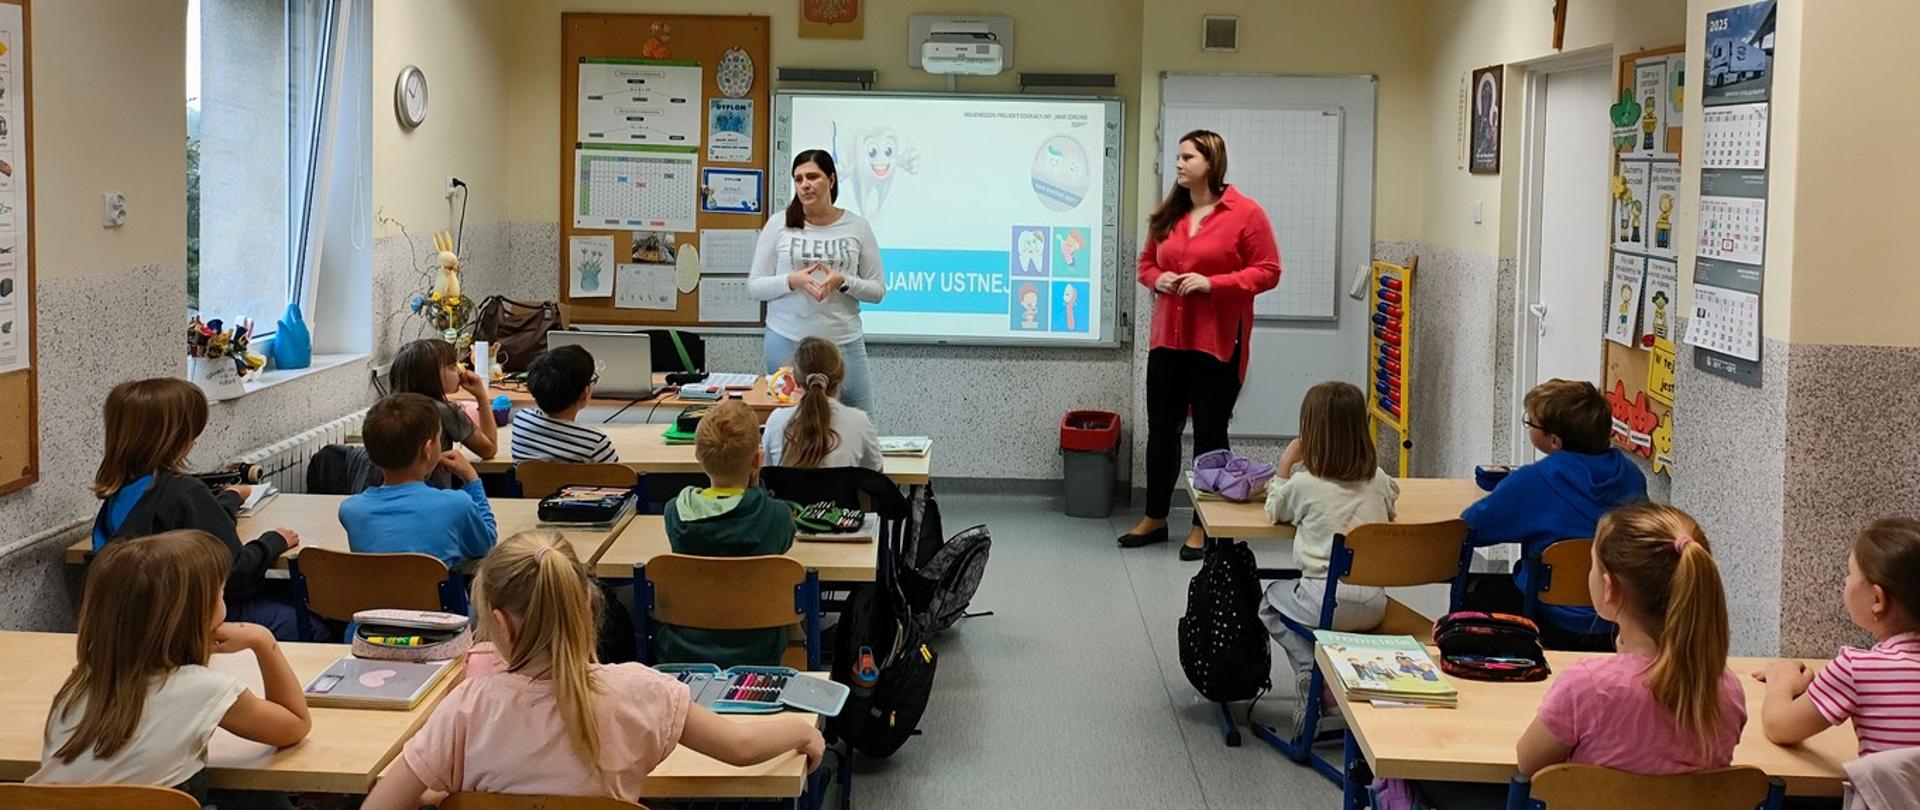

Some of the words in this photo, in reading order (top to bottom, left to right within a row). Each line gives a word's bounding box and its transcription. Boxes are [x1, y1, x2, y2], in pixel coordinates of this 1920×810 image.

[1709, 17, 1729, 32] 2025
[716, 103, 747, 111] DYPLOM
[789, 236, 852, 260] FLEUR
[886, 271, 940, 293] JAMY
[941, 271, 1010, 294] USTNEJ
